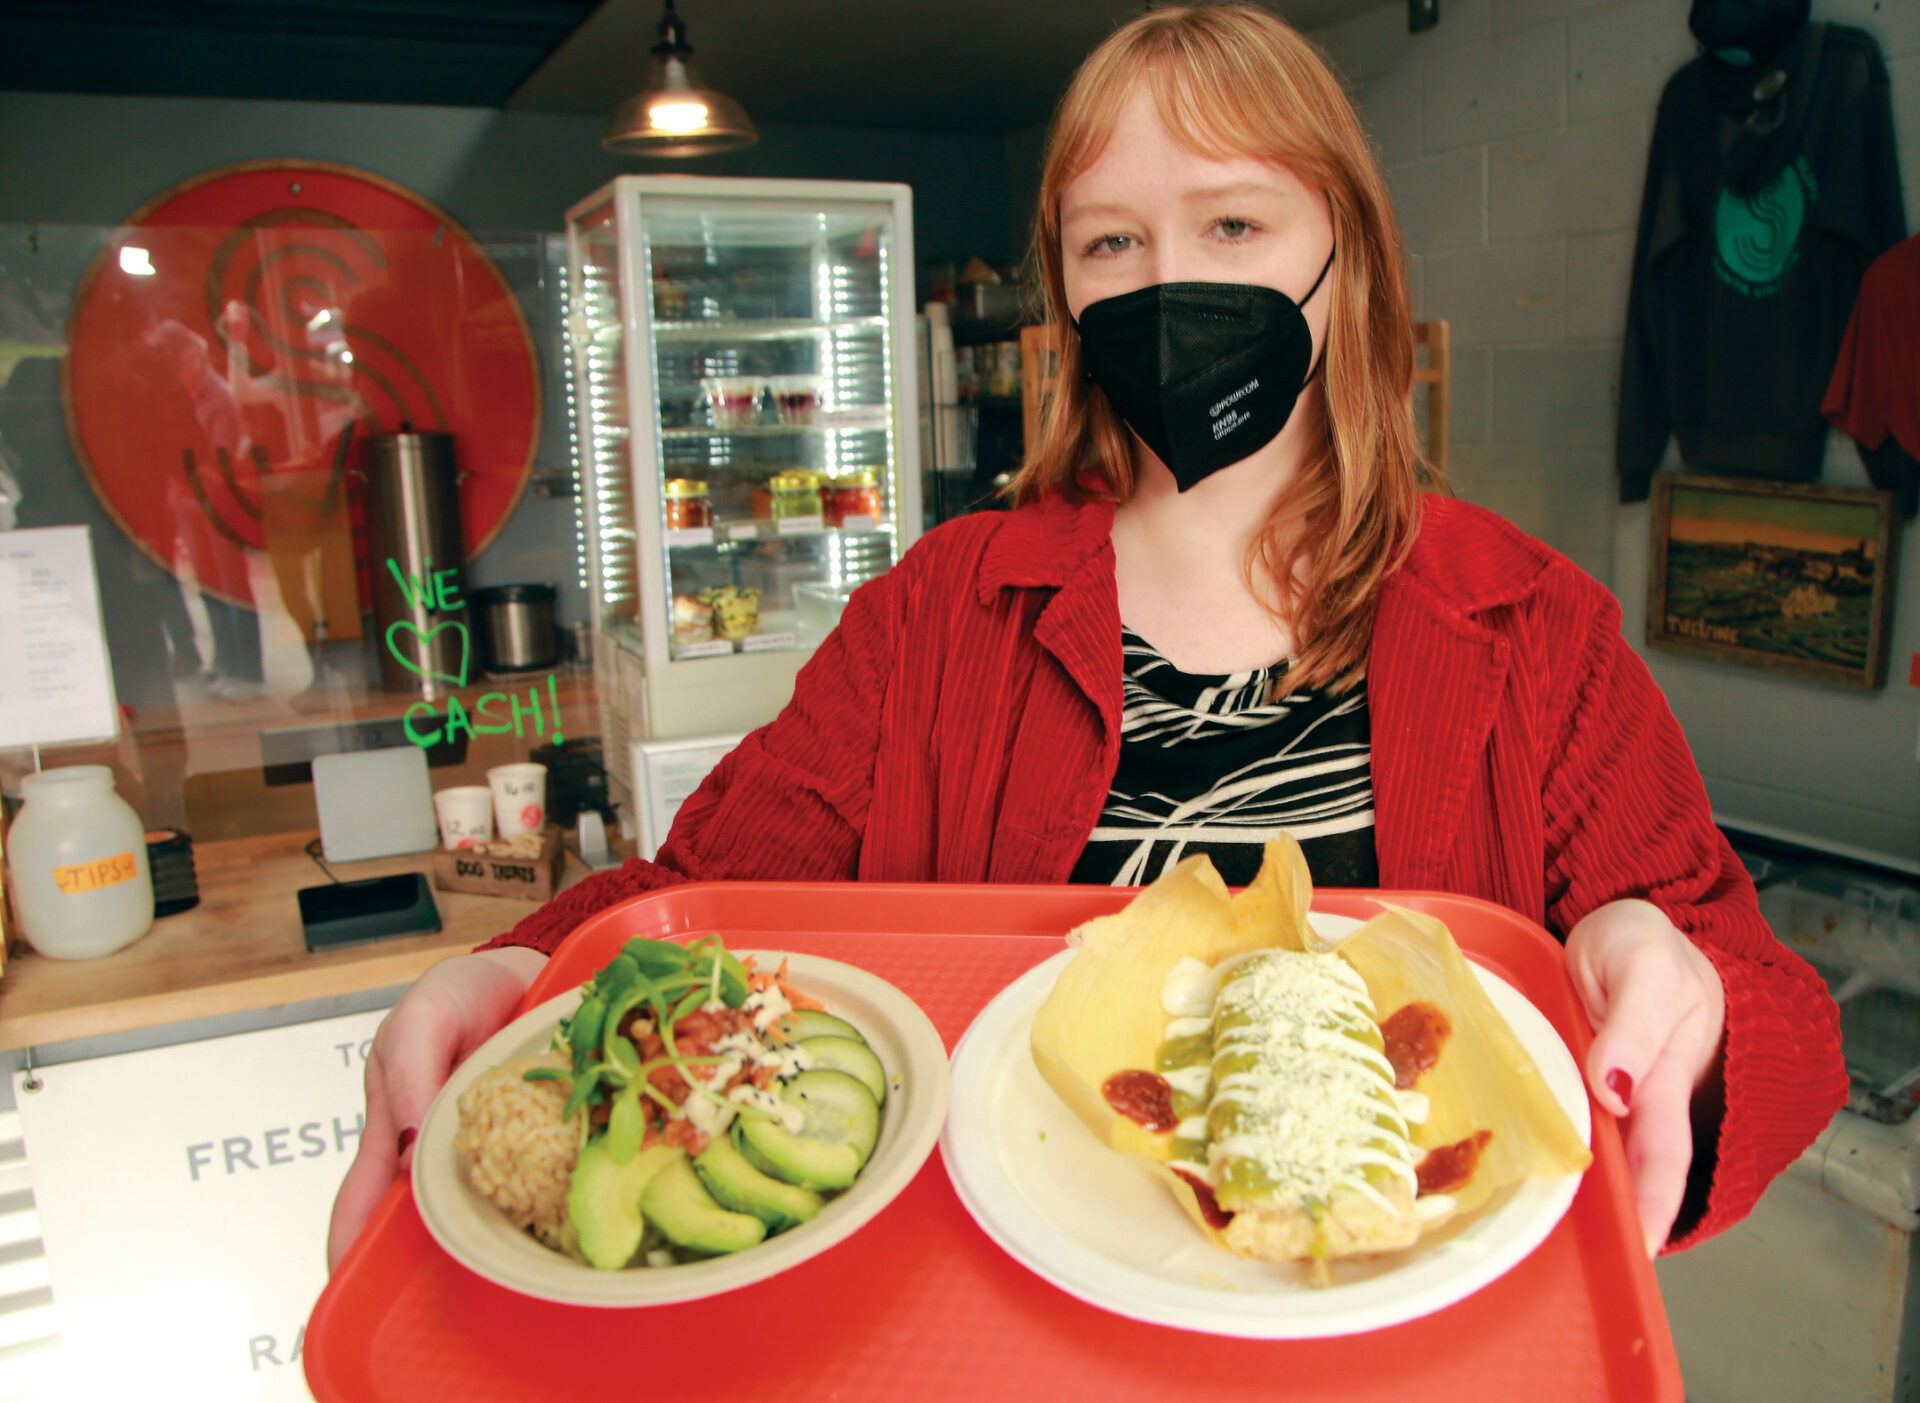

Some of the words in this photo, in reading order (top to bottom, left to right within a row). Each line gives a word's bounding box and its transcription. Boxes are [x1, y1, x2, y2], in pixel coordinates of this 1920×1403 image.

[386, 557, 466, 612] WE
[403, 674, 564, 749] CASH!
[65, 858, 122, 888] TIPS
[456, 859, 485, 878] DOG
[186, 1113, 365, 1182] FRESH
